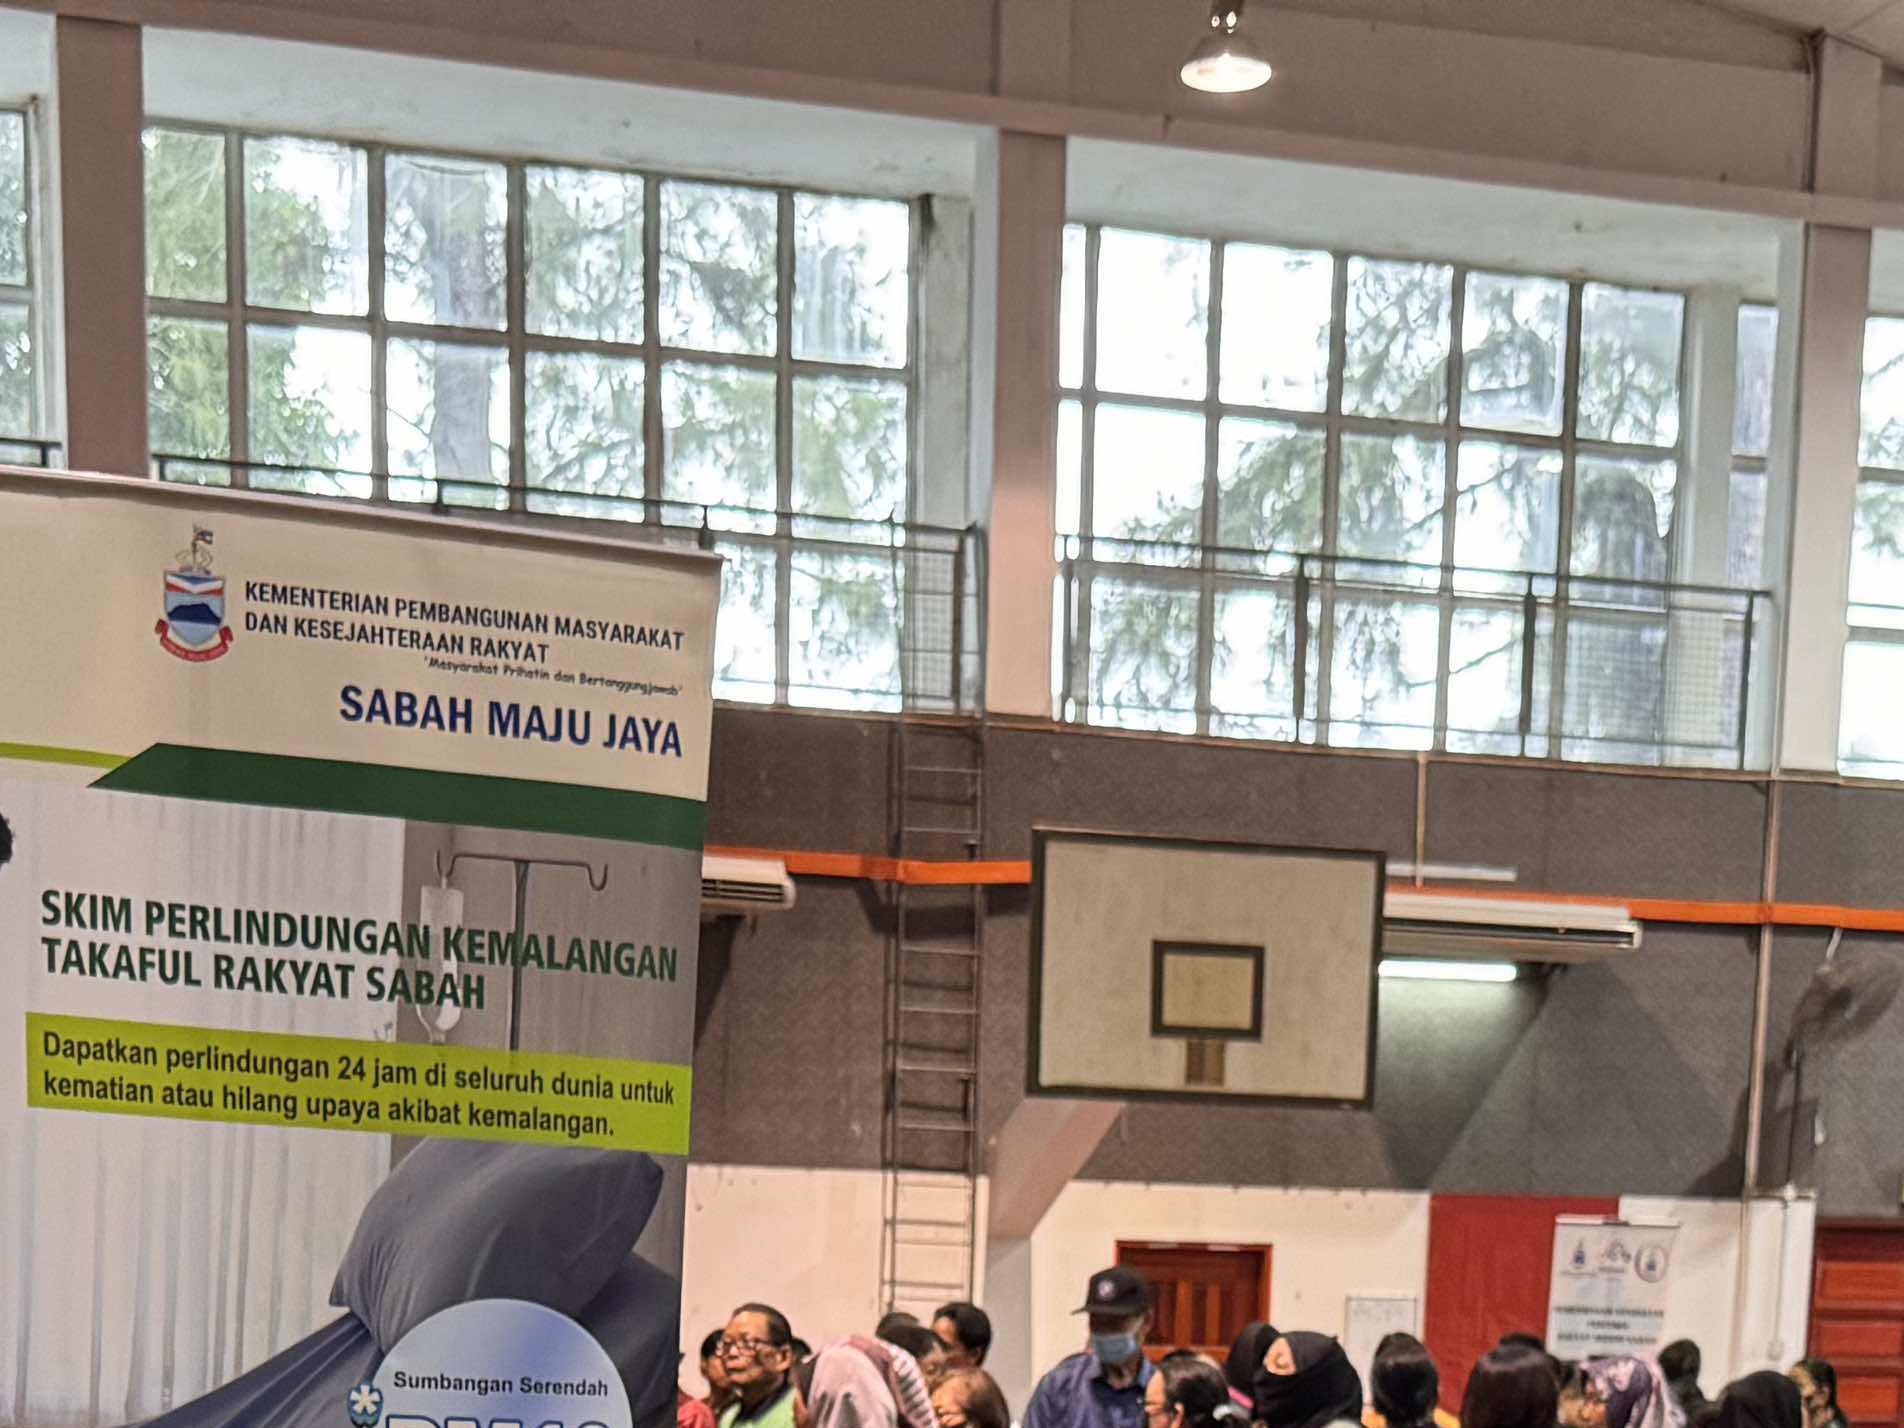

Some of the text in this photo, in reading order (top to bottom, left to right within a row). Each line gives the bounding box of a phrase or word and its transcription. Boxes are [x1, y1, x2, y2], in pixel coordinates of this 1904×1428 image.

[246, 581, 685, 652] KEMENTERIAN PEMBANGUNAN MASYARAKAT
[246, 612, 549, 665] DAN KESEJAHTERAAN RAKYAT
[340, 685, 682, 758] SABAH MAJU JAYA
[41, 889, 678, 982] SKIM PERLINDUNGAN KEMALANGAN
[41, 937, 485, 1010] TAKAFUL RAKYAT SABAH
[43, 1031, 675, 1107] Dapatkan perlindungan 24 jam di seluruh dunia untuk
[43, 1070, 615, 1139] kematian atau hilang upaya akibat kemalangan.
[394, 1371, 608, 1397] Sumbangan Serendah
